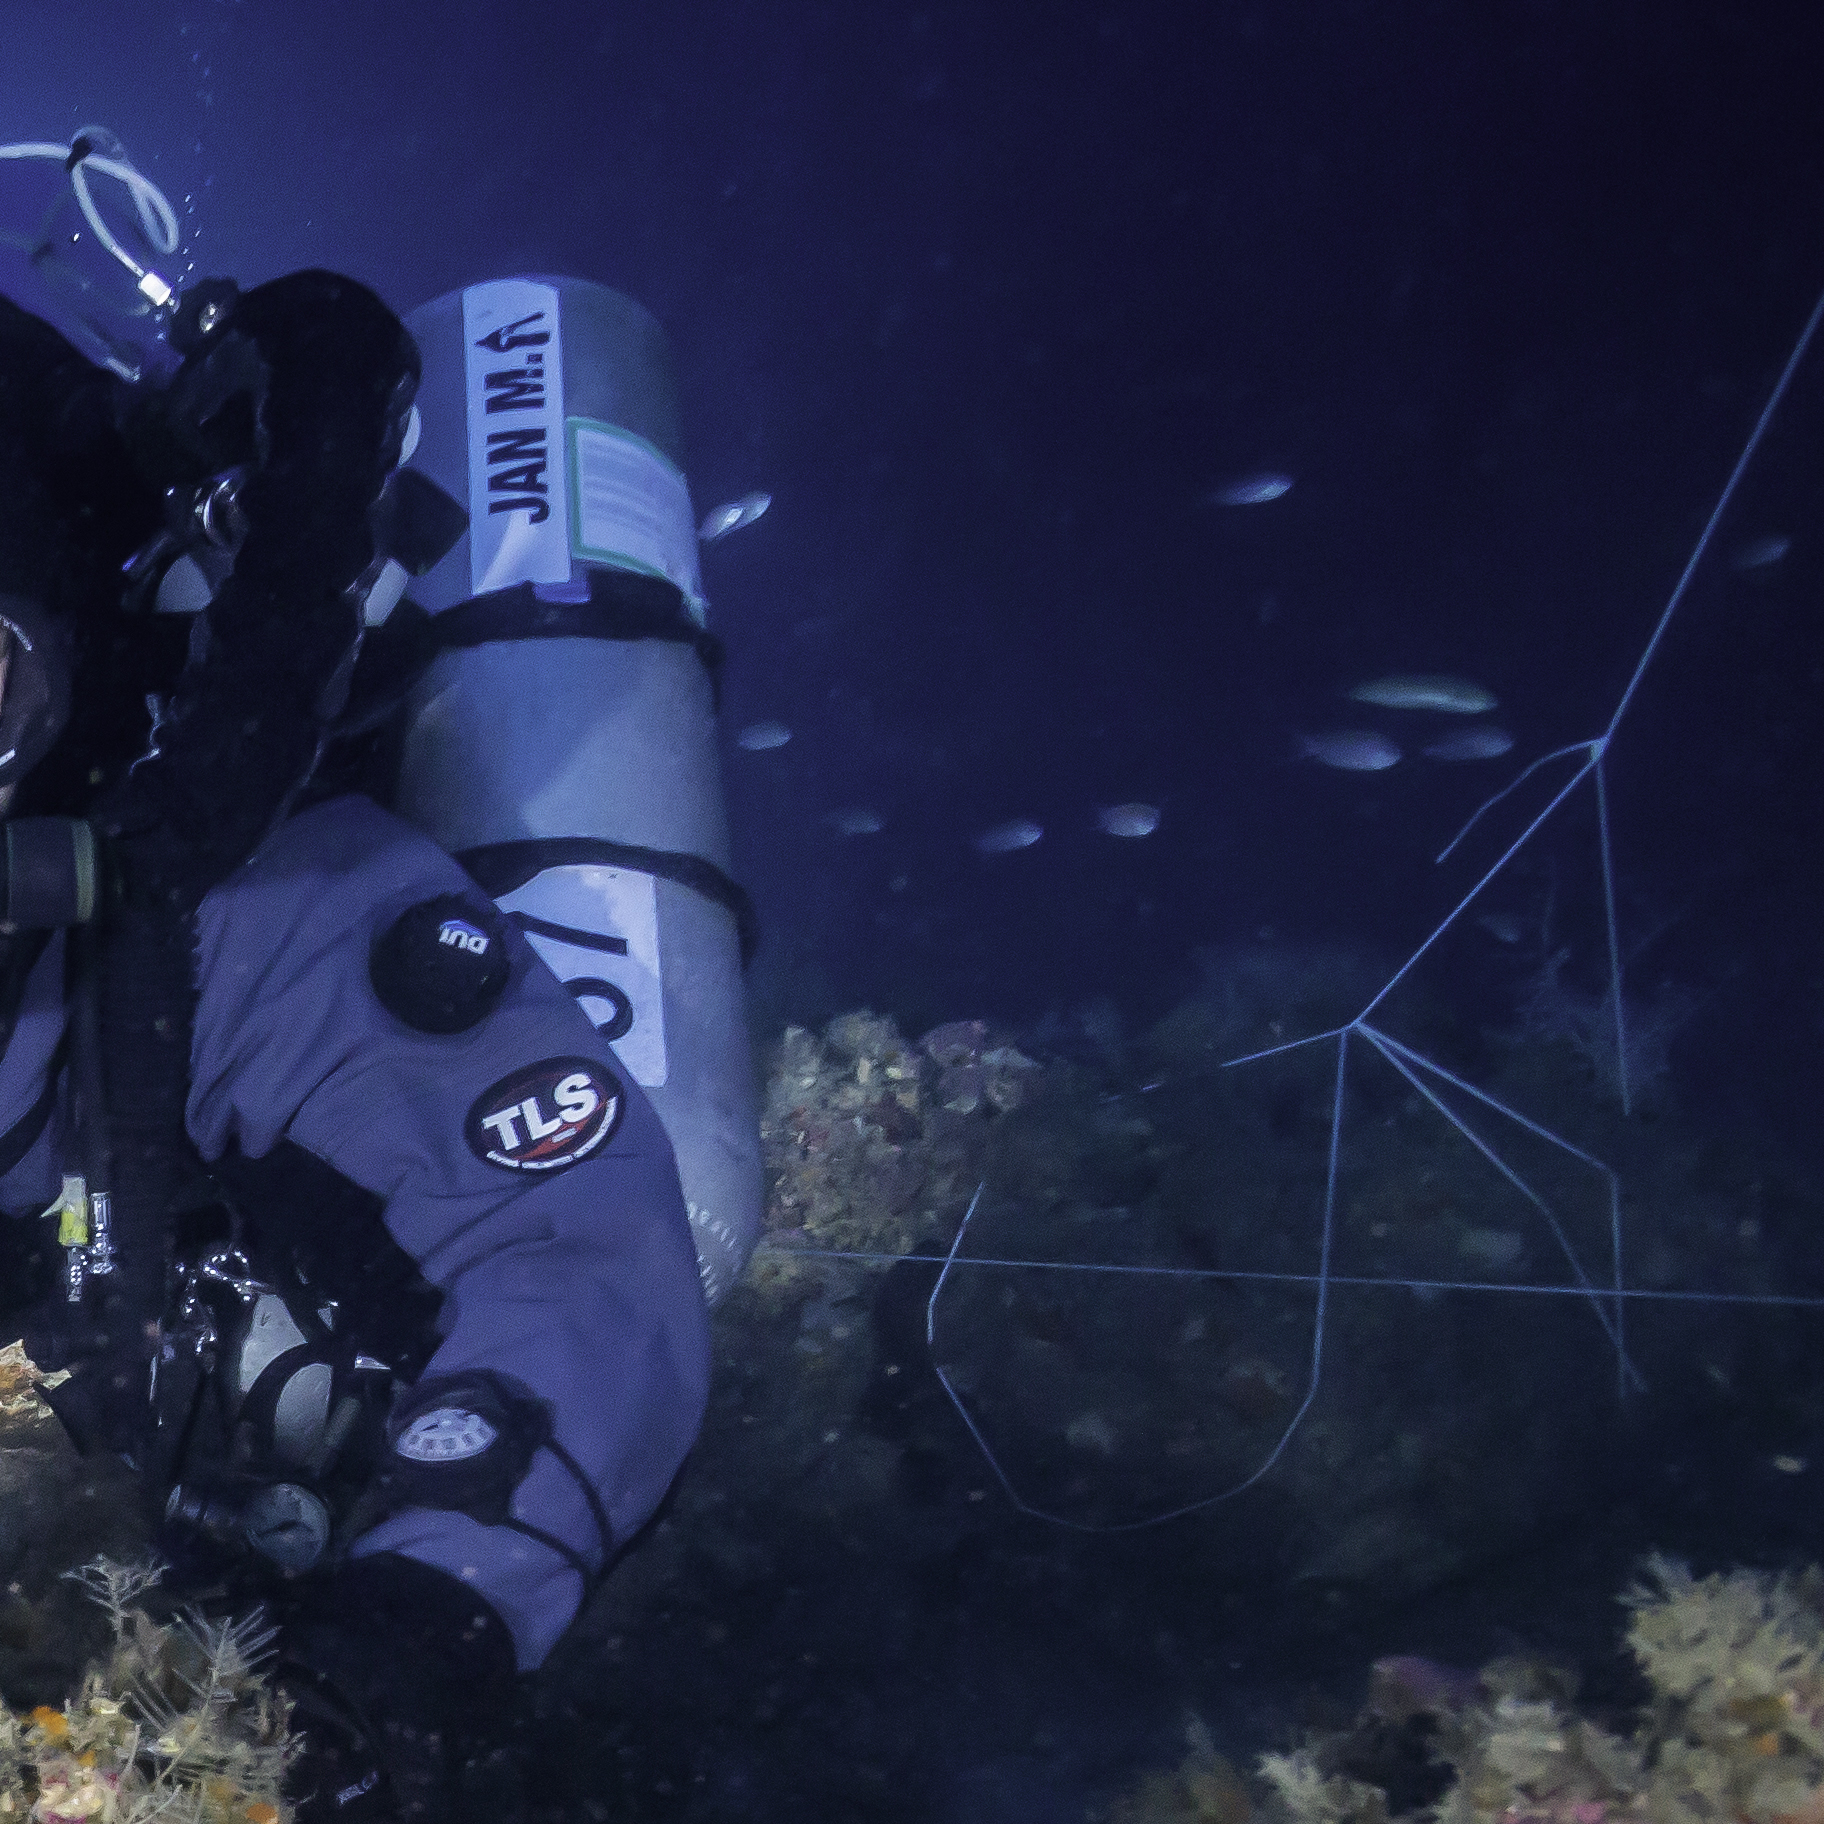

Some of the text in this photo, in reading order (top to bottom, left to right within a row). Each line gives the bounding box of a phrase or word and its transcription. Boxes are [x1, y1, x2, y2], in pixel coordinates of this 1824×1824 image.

[482, 353, 550, 526] JAN M.
[438, 929, 490, 955] DUI
[481, 1073, 600, 1151] TLS
